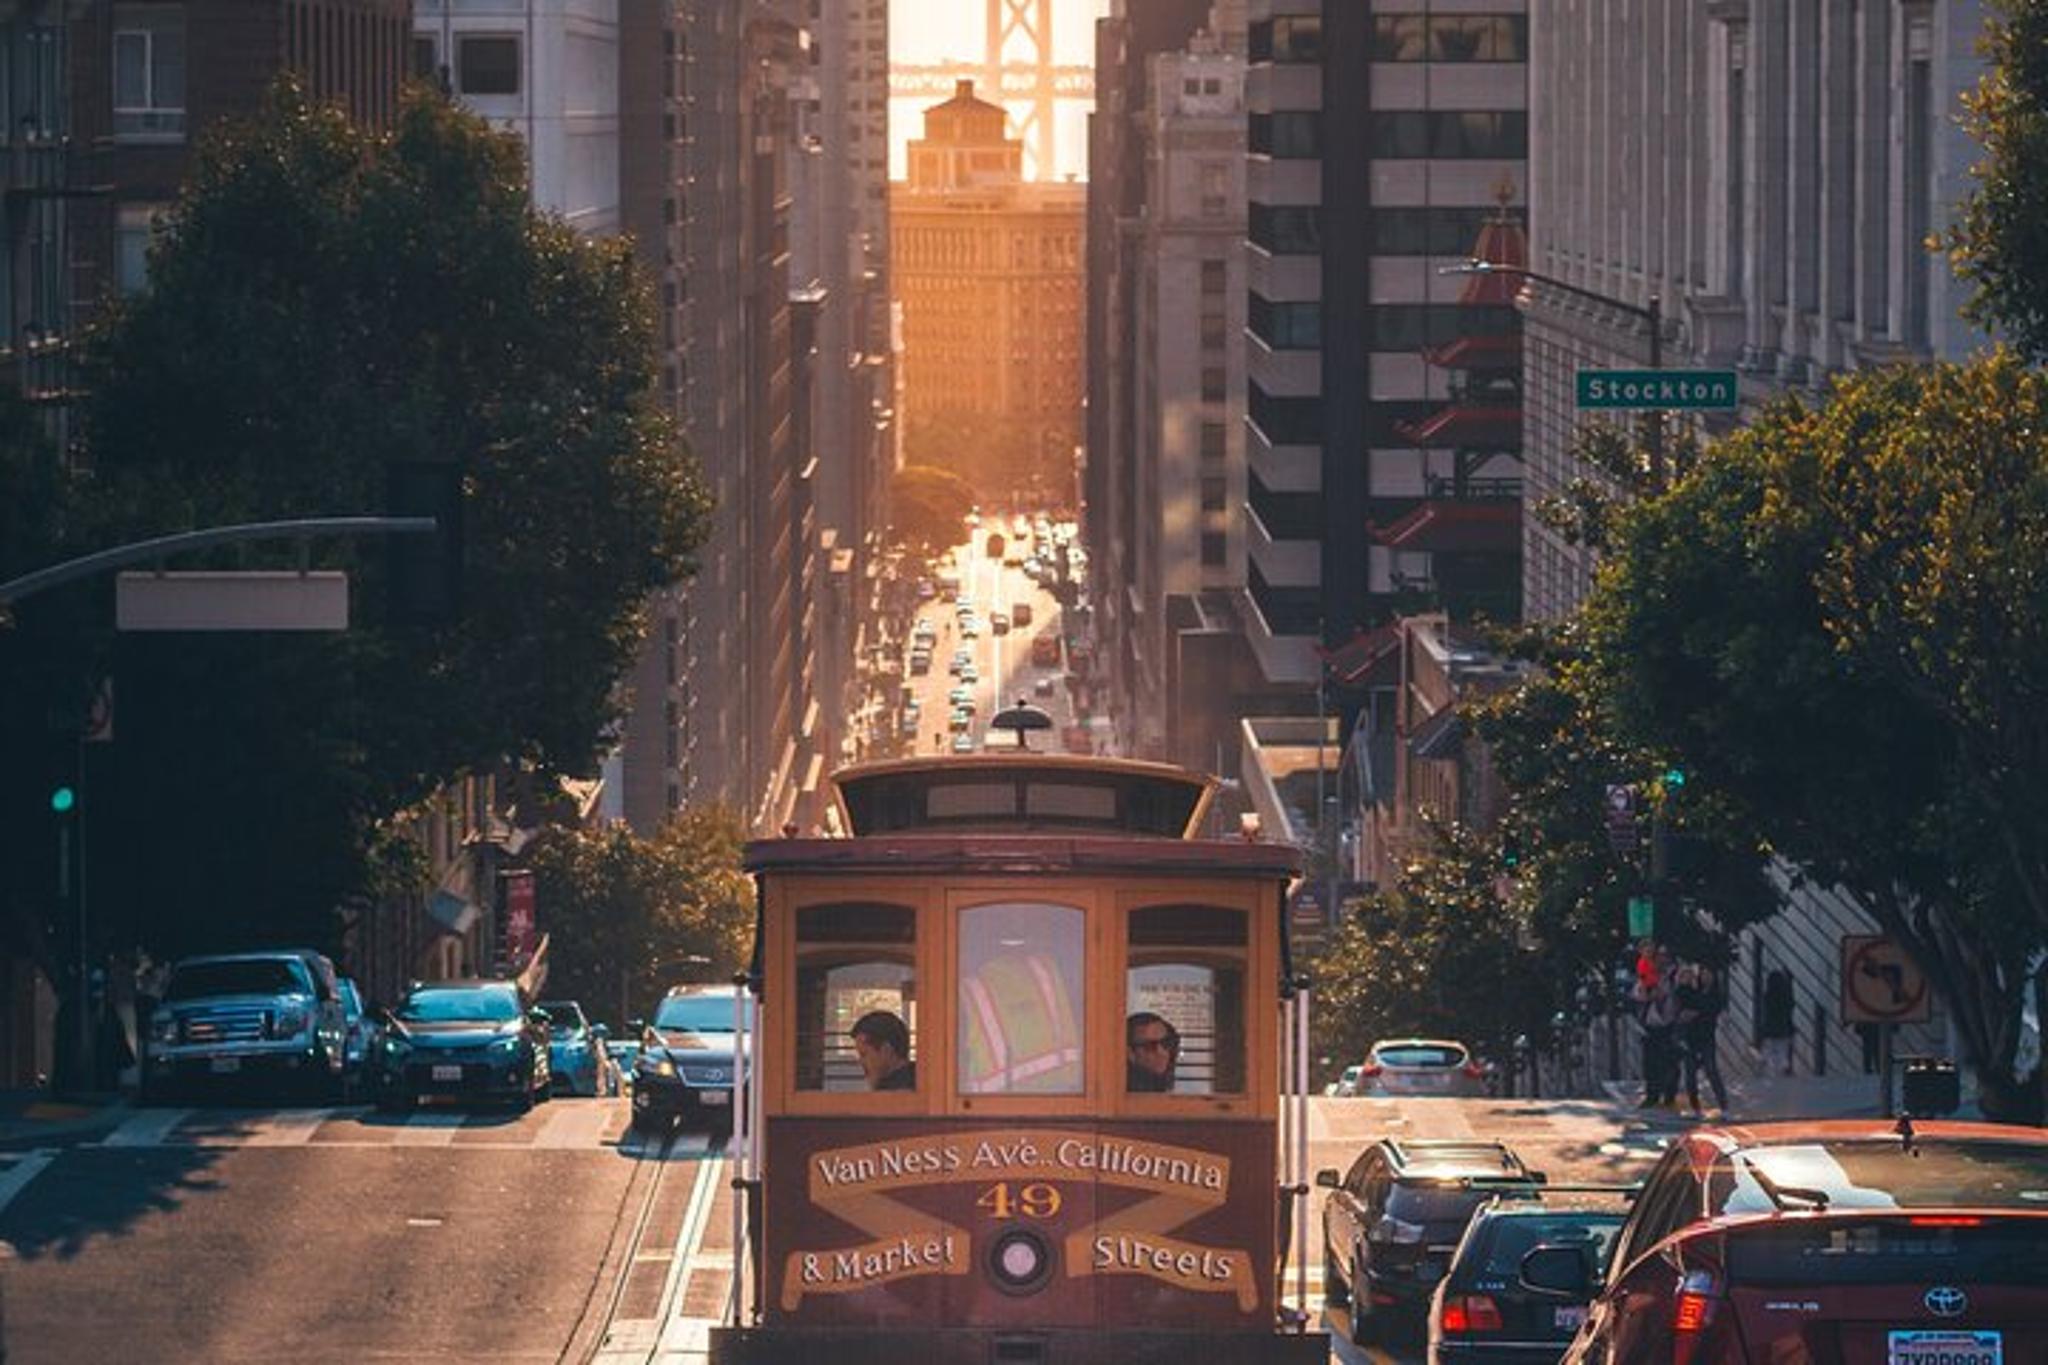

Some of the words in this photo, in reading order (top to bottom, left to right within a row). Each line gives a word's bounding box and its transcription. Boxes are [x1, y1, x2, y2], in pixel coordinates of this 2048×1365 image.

[1589, 378, 1726, 399] Stockton
[818, 1155, 875, 1185] Van
[880, 1145, 962, 1176] Ness
[1057, 1139, 1222, 1188] California
[976, 1182, 1061, 1217] 49
[803, 1253, 825, 1282] &
[835, 1236, 954, 1280] Market
[1095, 1236, 1233, 1279] Streets
